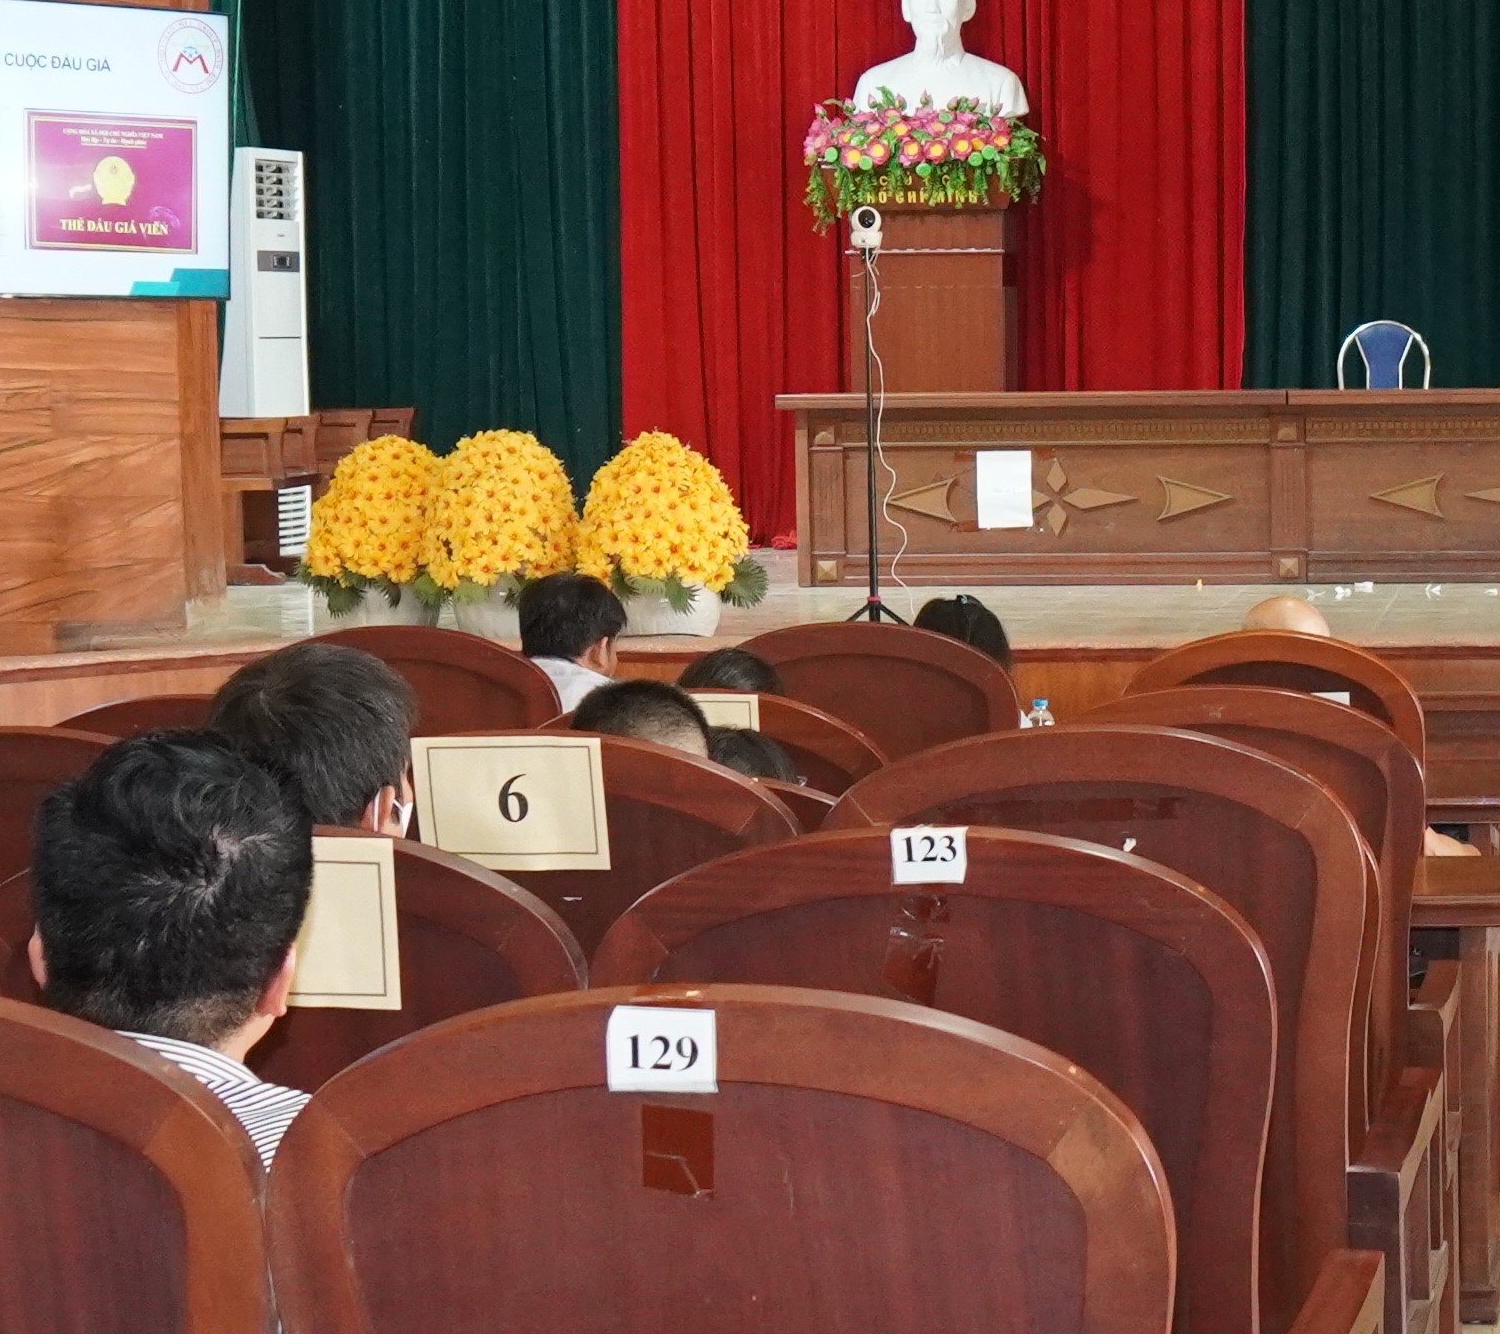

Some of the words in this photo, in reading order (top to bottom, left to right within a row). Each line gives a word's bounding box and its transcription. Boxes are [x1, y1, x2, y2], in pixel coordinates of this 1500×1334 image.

[497, 773, 530, 824] 6
[903, 835, 957, 863] 123
[624, 1033, 700, 1071] 129
